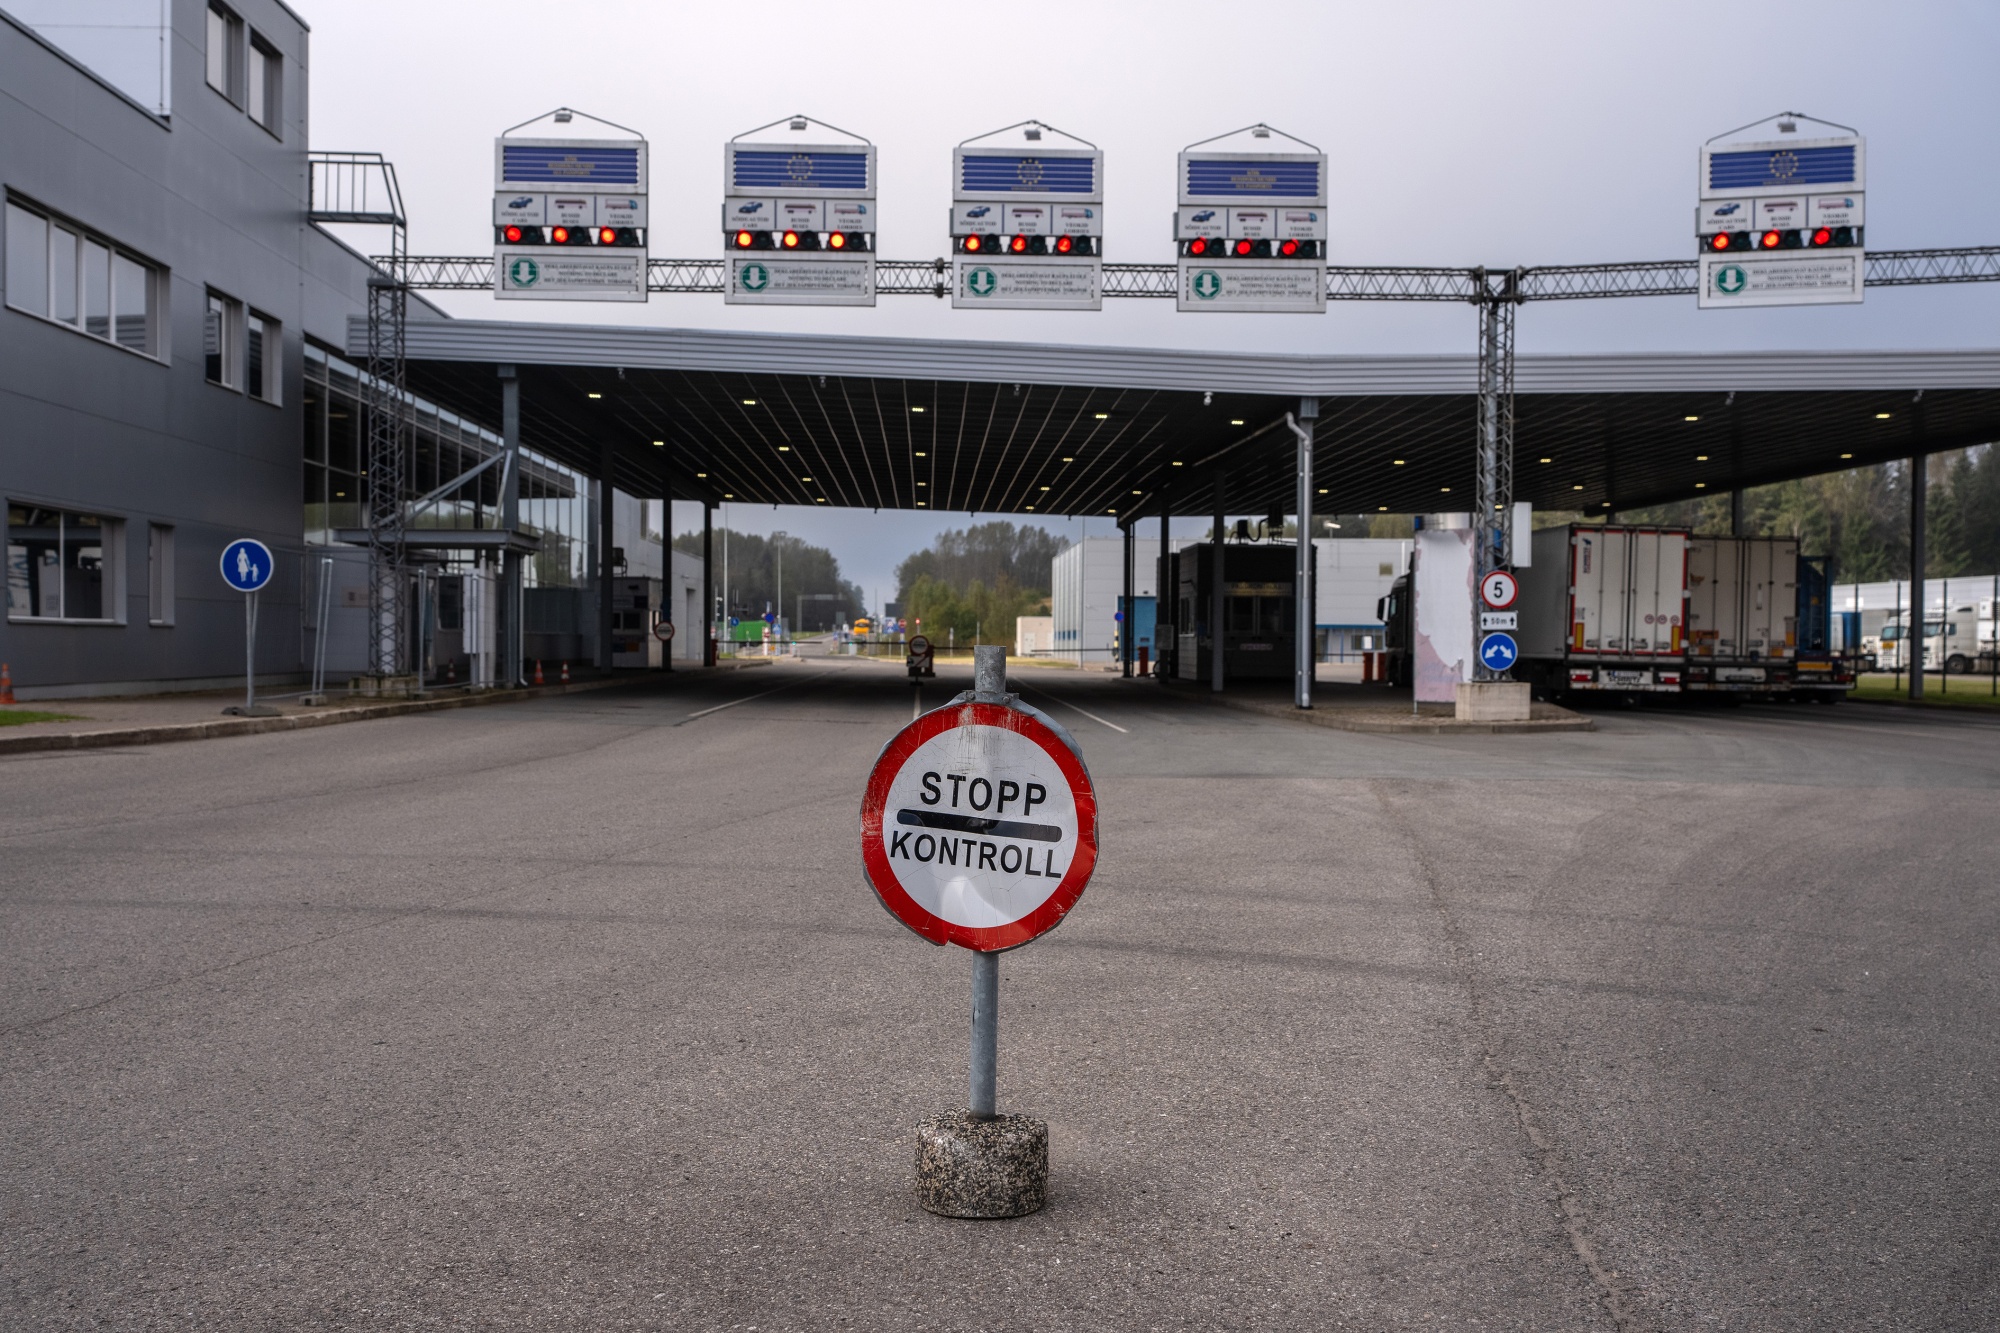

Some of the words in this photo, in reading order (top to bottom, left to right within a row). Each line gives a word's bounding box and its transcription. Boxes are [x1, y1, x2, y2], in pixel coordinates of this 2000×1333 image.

[1494, 582, 1503, 598] 5
[920, 771, 1047, 816] STOPP
[890, 830, 1062, 878] KONTROLL
